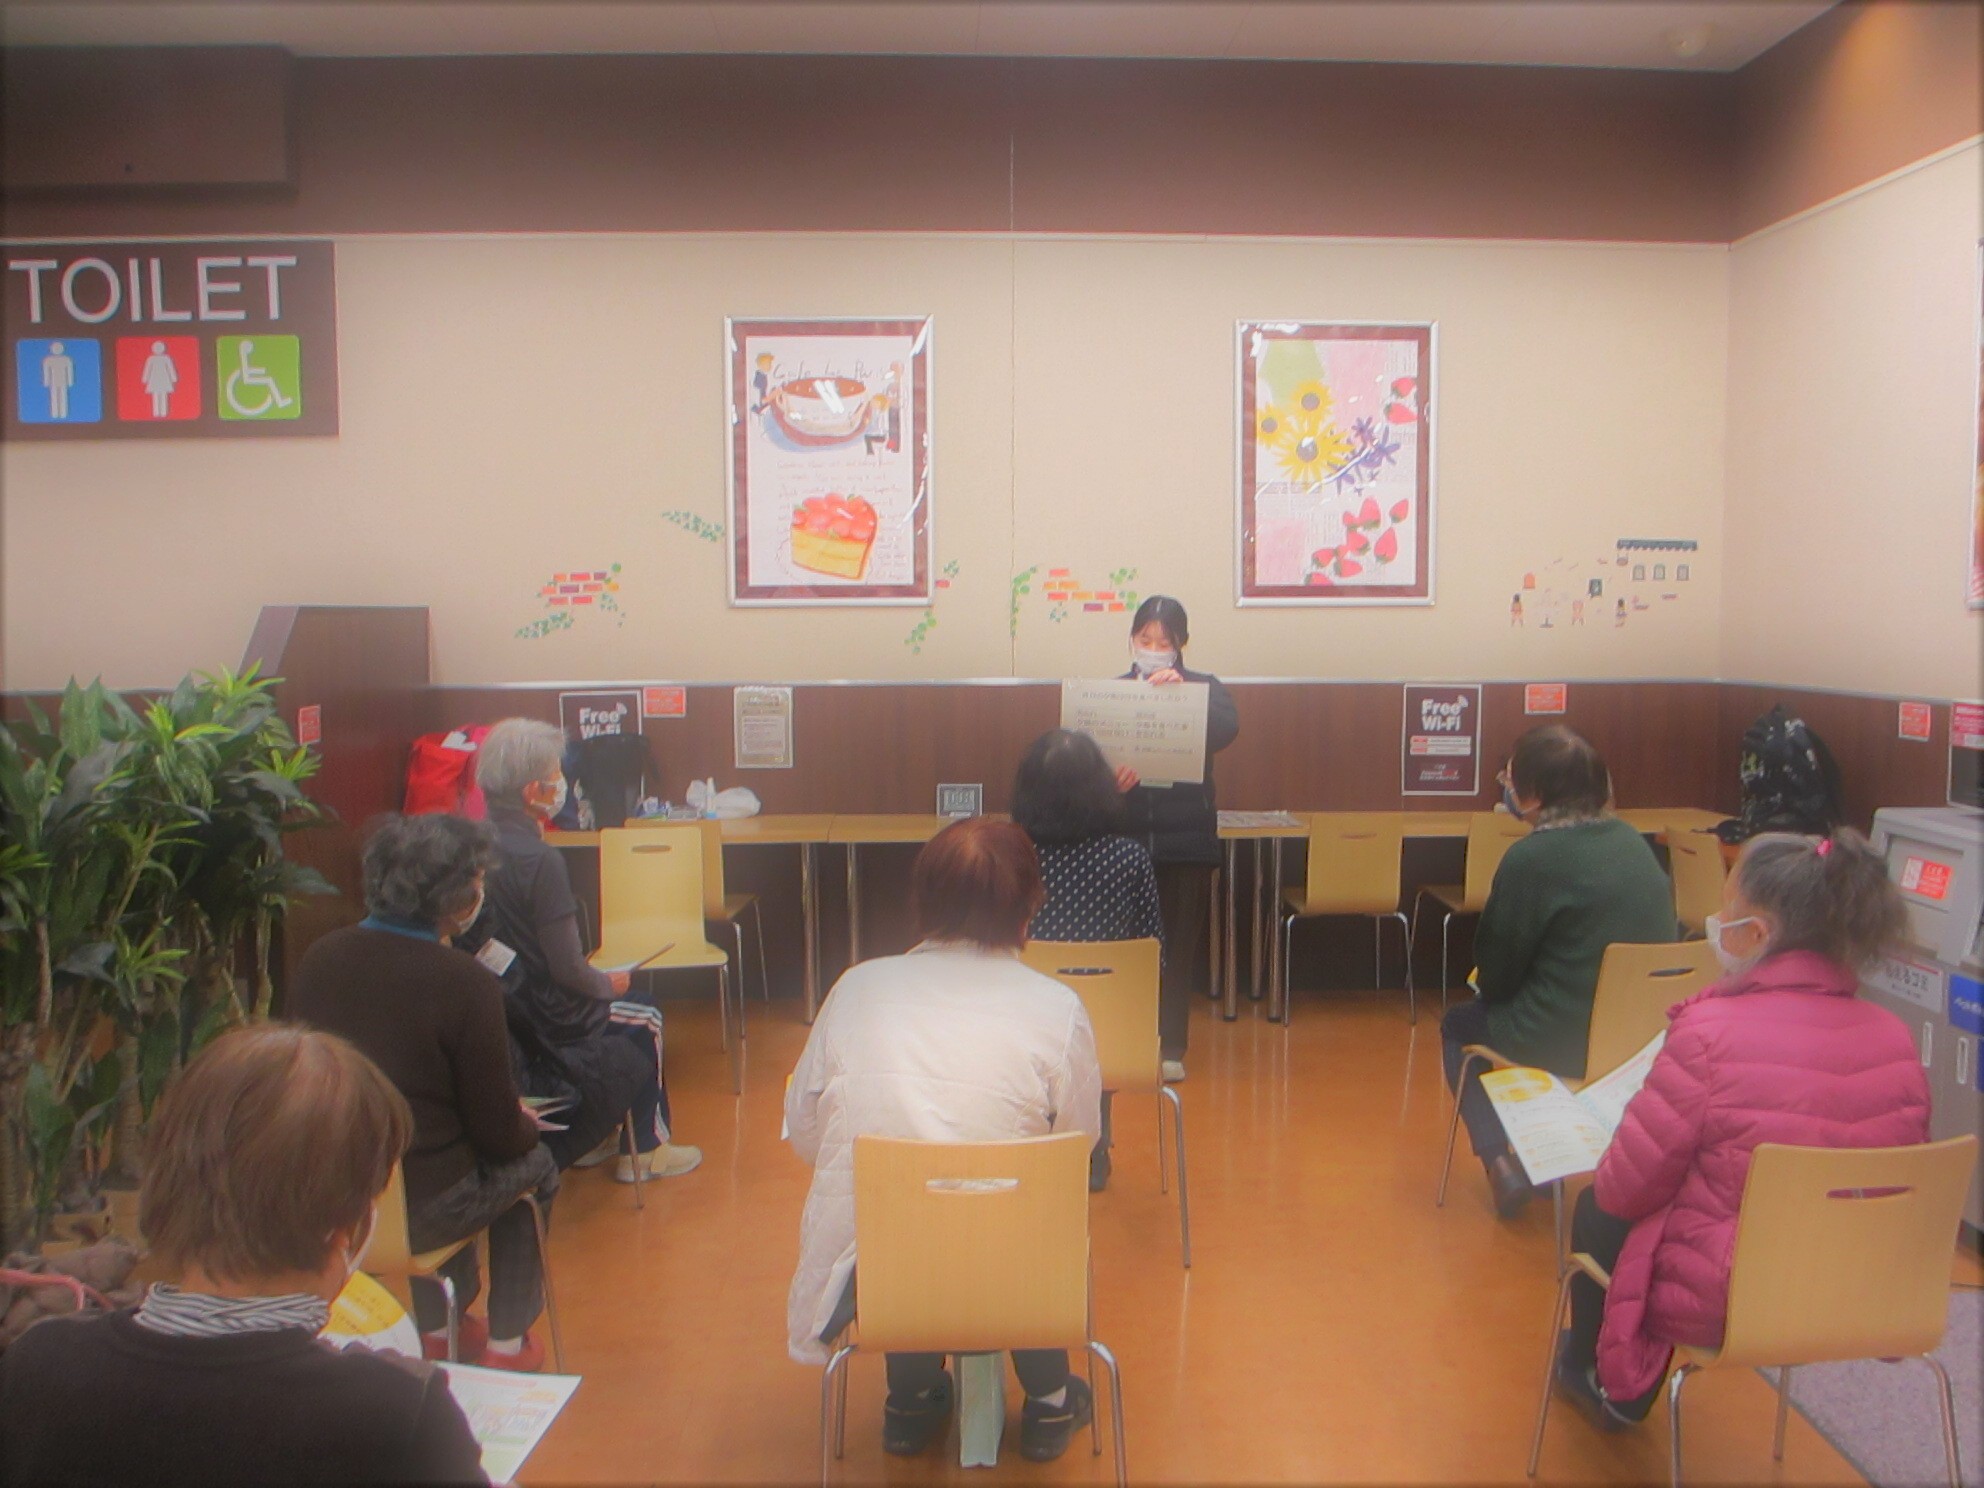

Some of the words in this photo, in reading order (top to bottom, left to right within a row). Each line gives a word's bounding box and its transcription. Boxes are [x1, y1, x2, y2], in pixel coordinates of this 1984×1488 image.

[8, 256, 297, 323] TOILET
[1422, 699, 1461, 715] Free
[579, 707, 620, 724] Free
[1422, 715, 1461, 731] Wi-Fi
[580, 723, 621, 739] Wi-Fi
